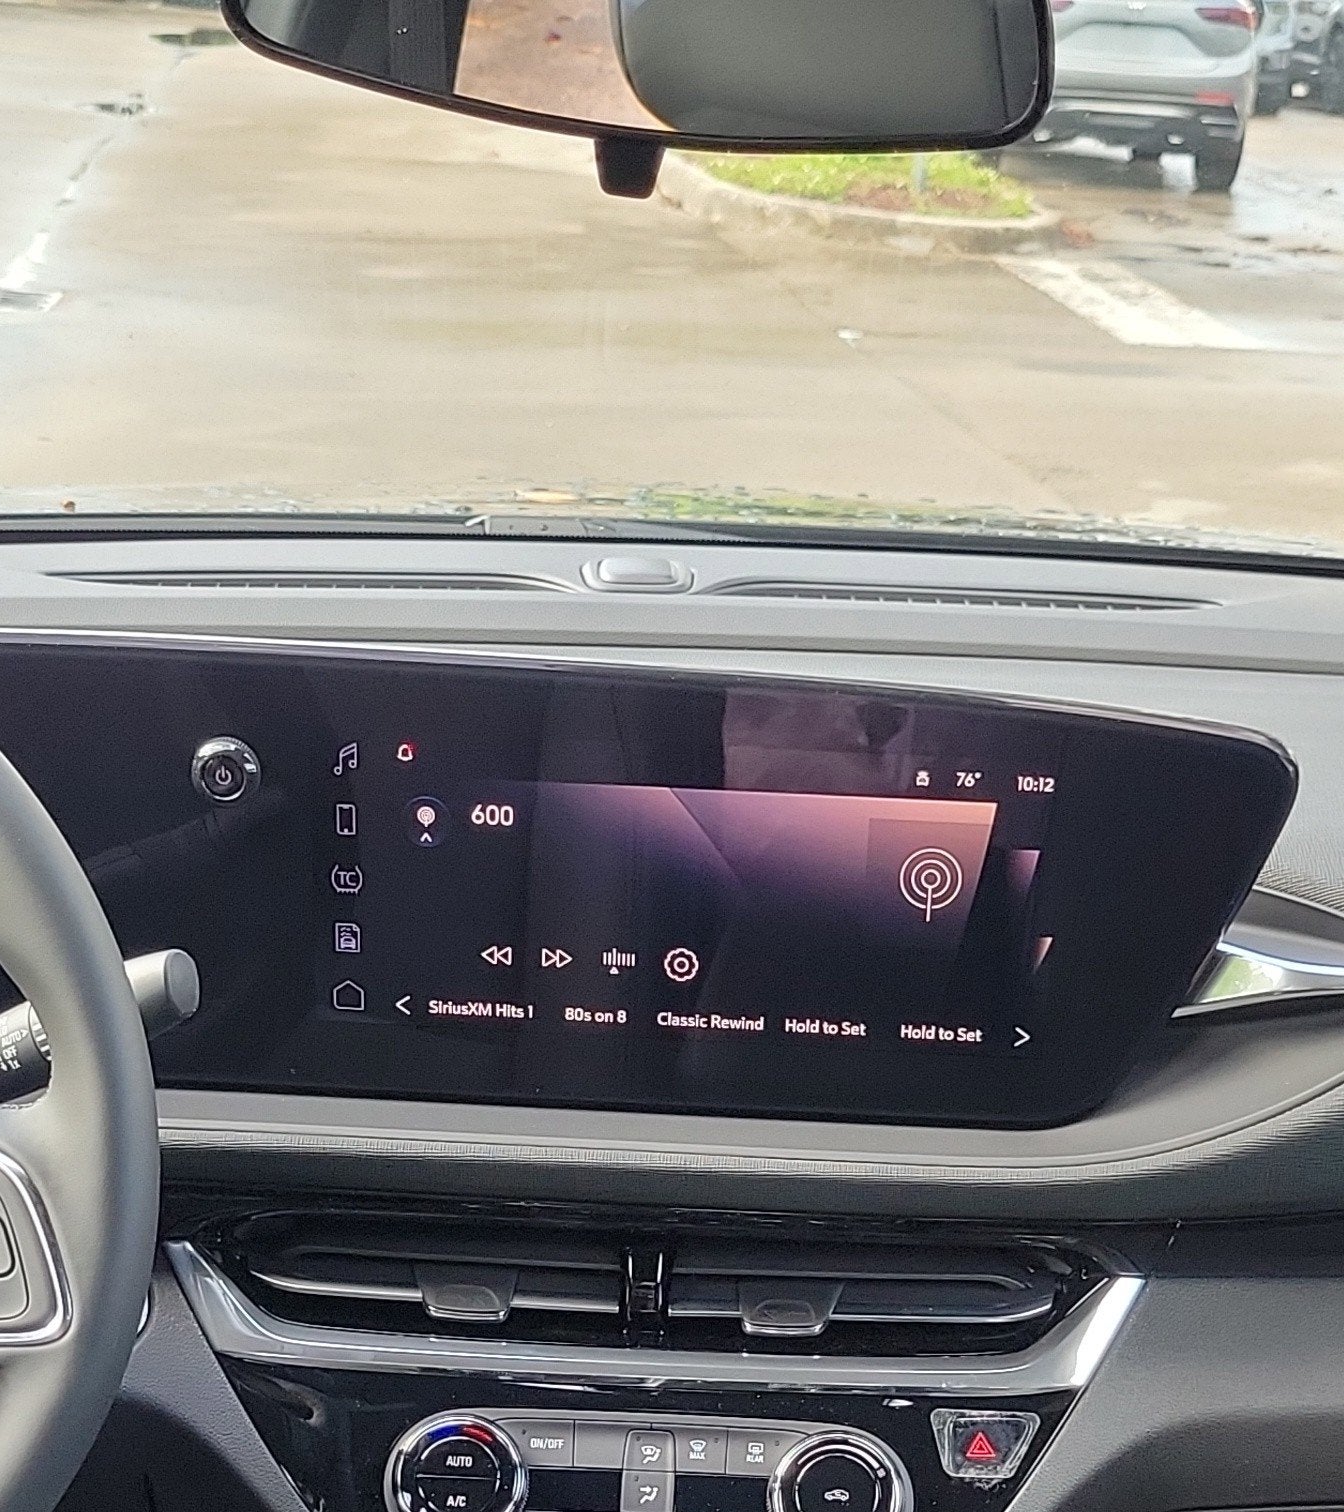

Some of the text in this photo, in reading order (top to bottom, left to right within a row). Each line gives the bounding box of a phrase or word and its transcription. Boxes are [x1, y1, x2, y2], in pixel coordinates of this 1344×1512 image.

[1017, 776, 1055, 793] 10:12
[470, 804, 514, 827] 600
[428, 999, 534, 1020] SiriusXM Hits 1
[564, 1007, 628, 1024] 80s on 8
[656, 1011, 765, 1031] Classic Rewind
[784, 1017, 868, 1037] Hold to Set
[900, 1024, 984, 1043] Hold to Set
[529, 1437, 565, 1450] ON/OFF
[445, 1455, 474, 1468] AUTO
[445, 1495, 467, 1508] A/C
